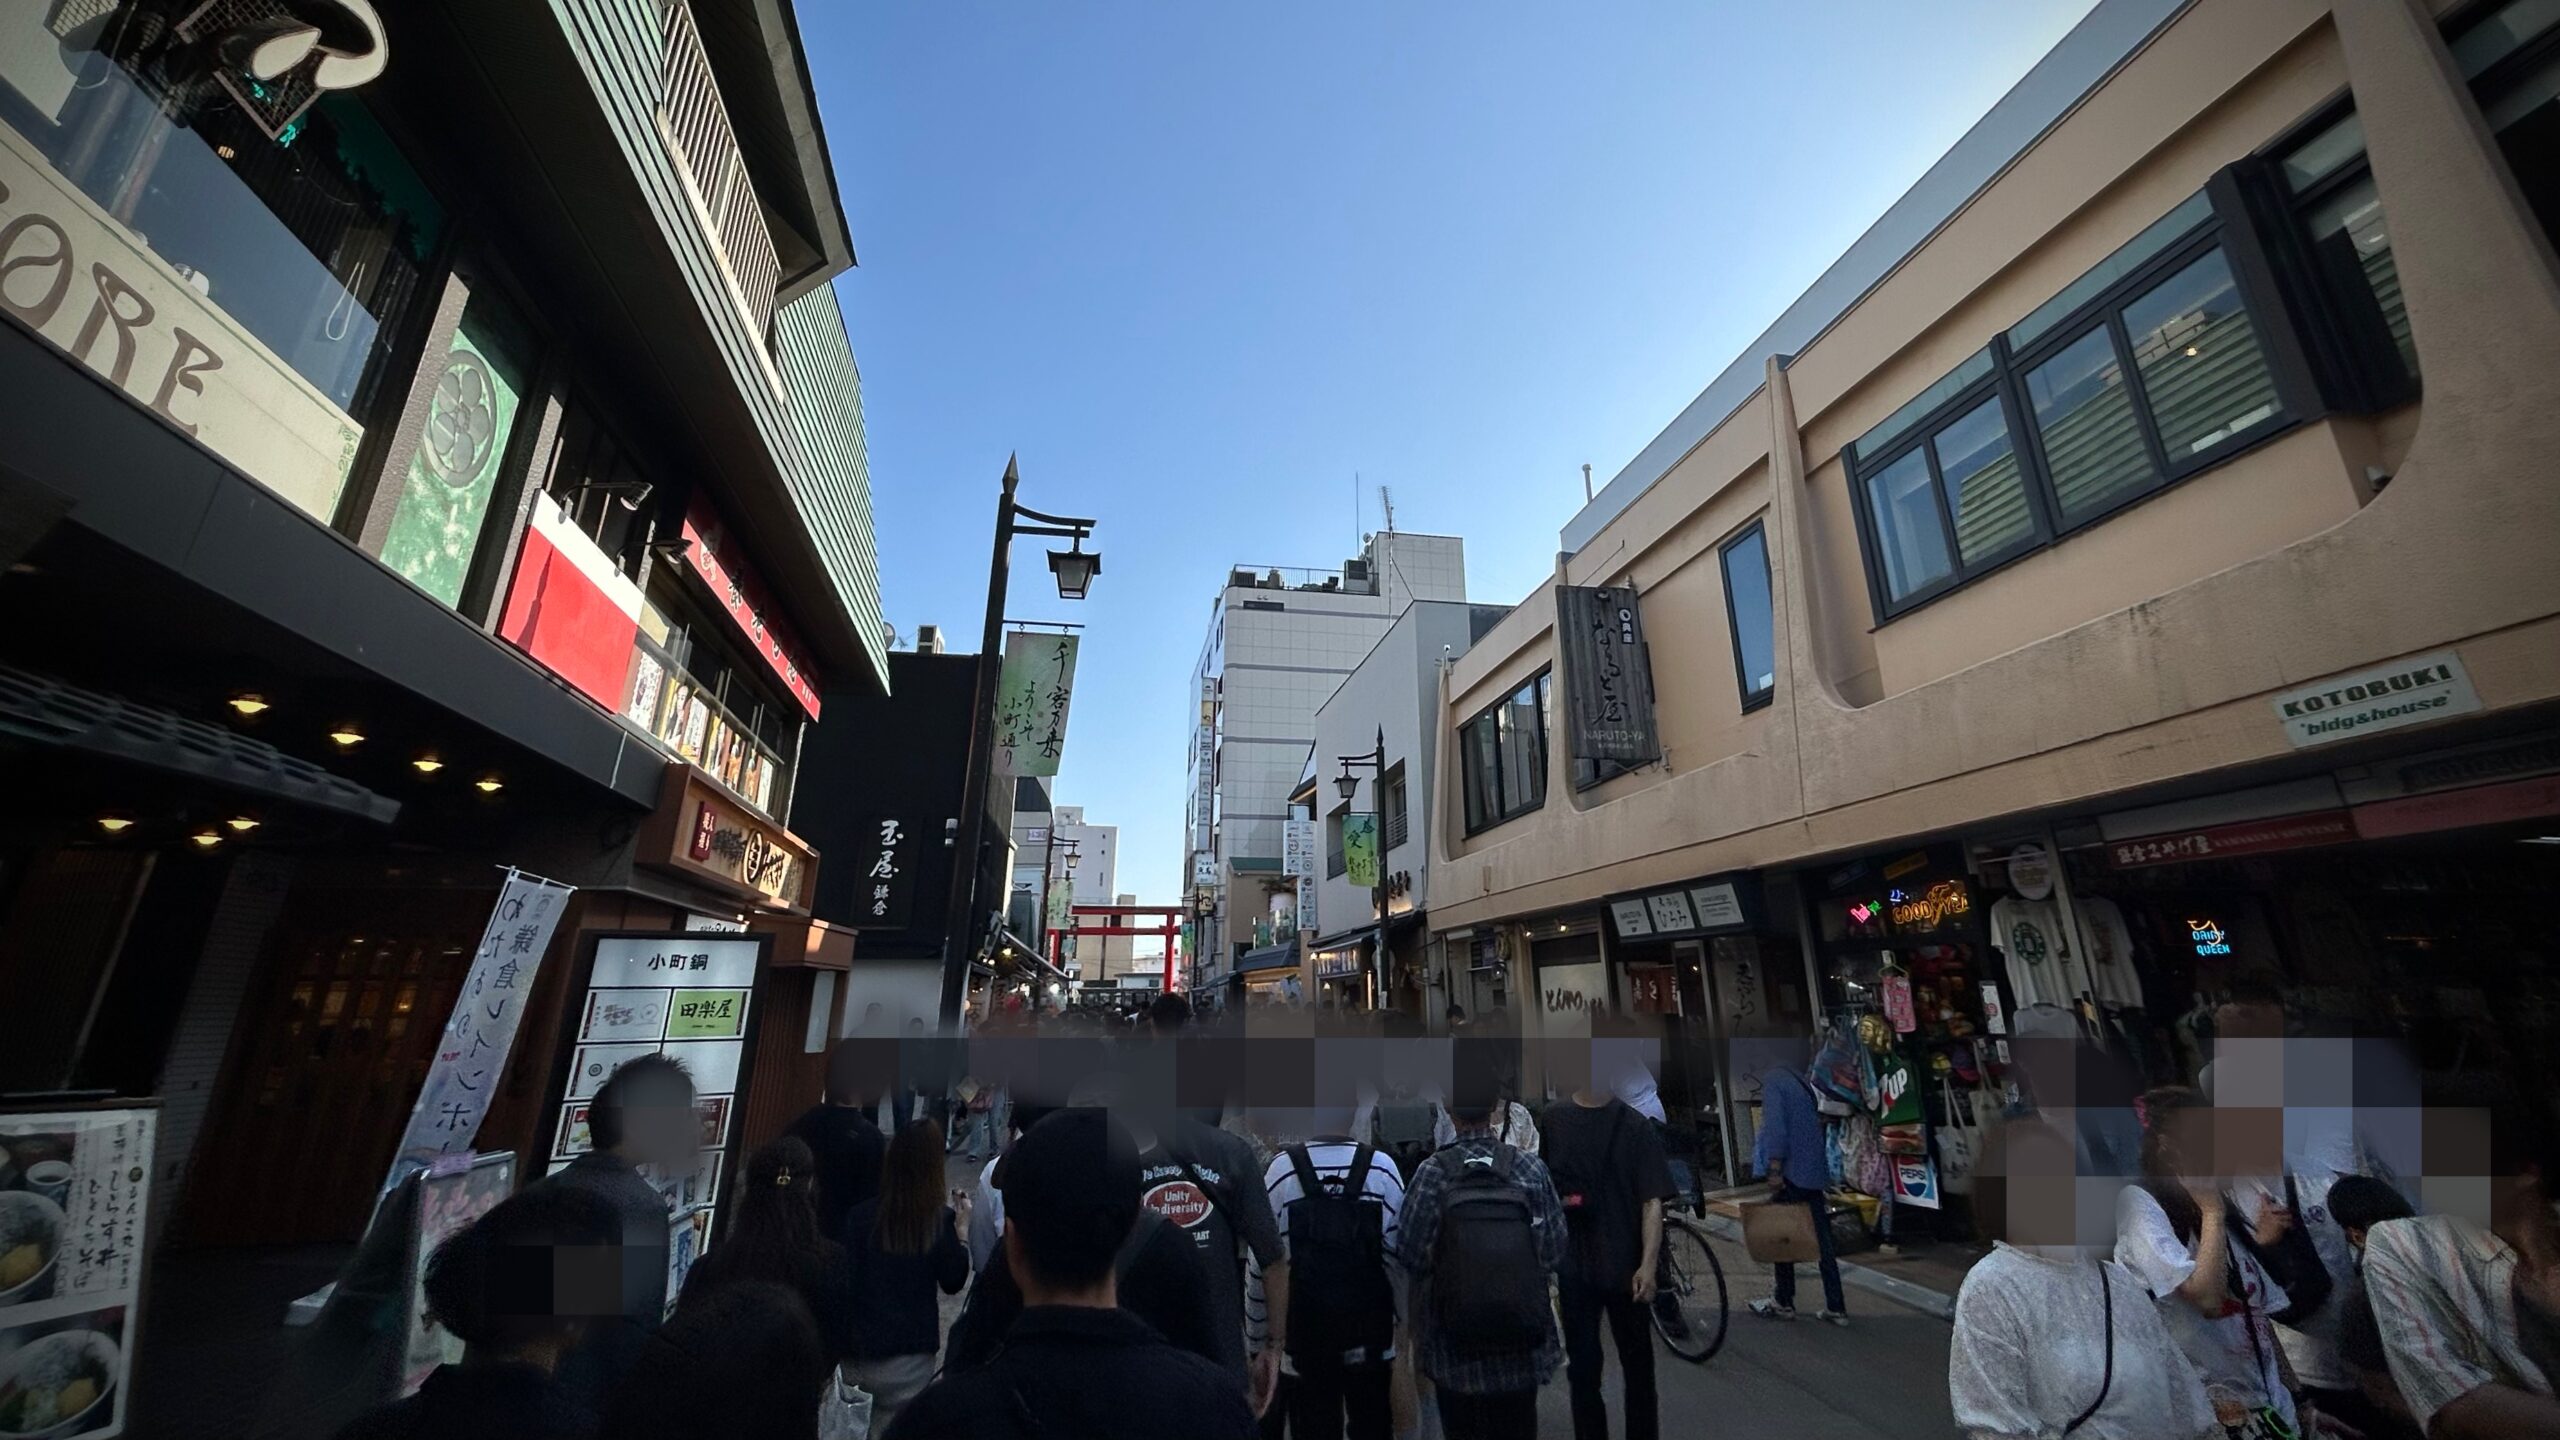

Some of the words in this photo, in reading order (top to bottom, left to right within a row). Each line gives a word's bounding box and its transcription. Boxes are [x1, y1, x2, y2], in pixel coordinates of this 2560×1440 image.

[0, 183, 223, 438] ORE
[1036, 642, 1069, 758] 千客万来
[2283, 664, 2452, 717] KOTOBUKI
[1000, 698, 1022, 768] 小町通り
[869, 820, 904, 879] 玉屋
[2196, 944, 2230, 956] QUEEN
[680, 999, 733, 1019] 田楽屋
[1161, 1201, 1204, 1215] diversity
[1165, 1190, 1190, 1203] Unity
